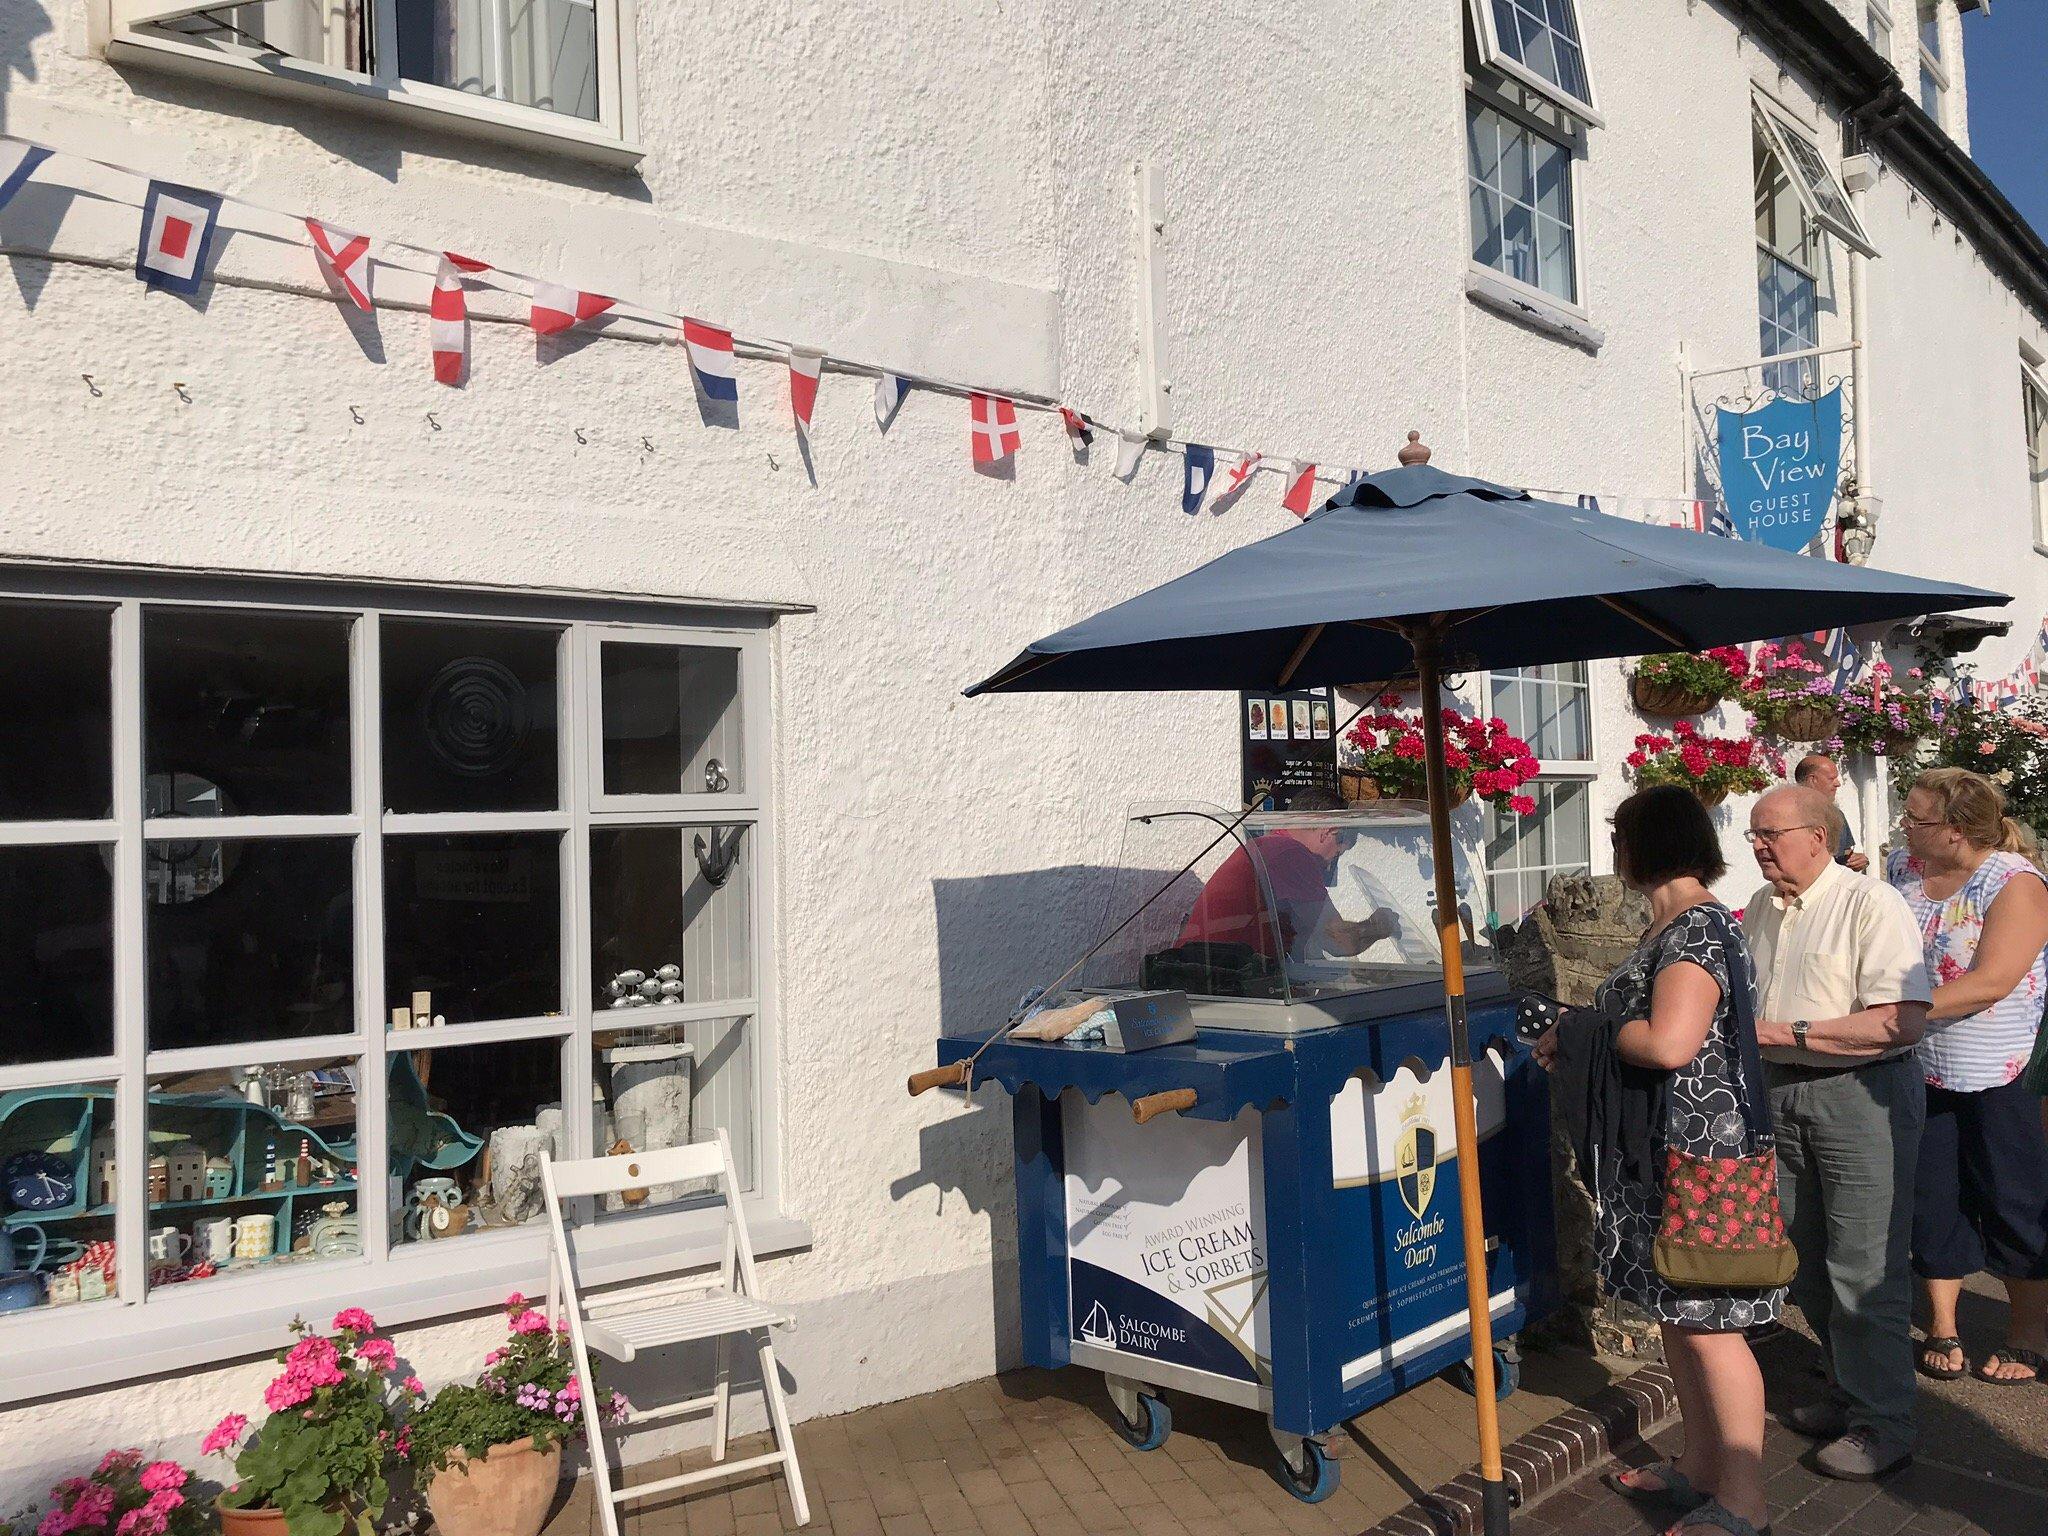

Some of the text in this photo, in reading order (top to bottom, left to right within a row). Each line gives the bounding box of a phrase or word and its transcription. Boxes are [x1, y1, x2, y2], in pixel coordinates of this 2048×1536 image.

[1741, 425, 1810, 462] Bay
[1751, 456, 1826, 491] View
[1748, 508, 1812, 529] HOUSE
[1749, 492, 1811, 513] GUEST
[1143, 1202, 1246, 1248] AWARD WINNING
[1393, 1211, 1446, 1252] Salcombe
[1140, 1222, 1257, 1276] ICE CREAM
[1404, 1242, 1438, 1270] Dairy
[1168, 1247, 1264, 1293] & SORBETS
[1118, 1314, 1186, 1343] SALCOMBE
[1120, 1330, 1159, 1351] DAIRY
